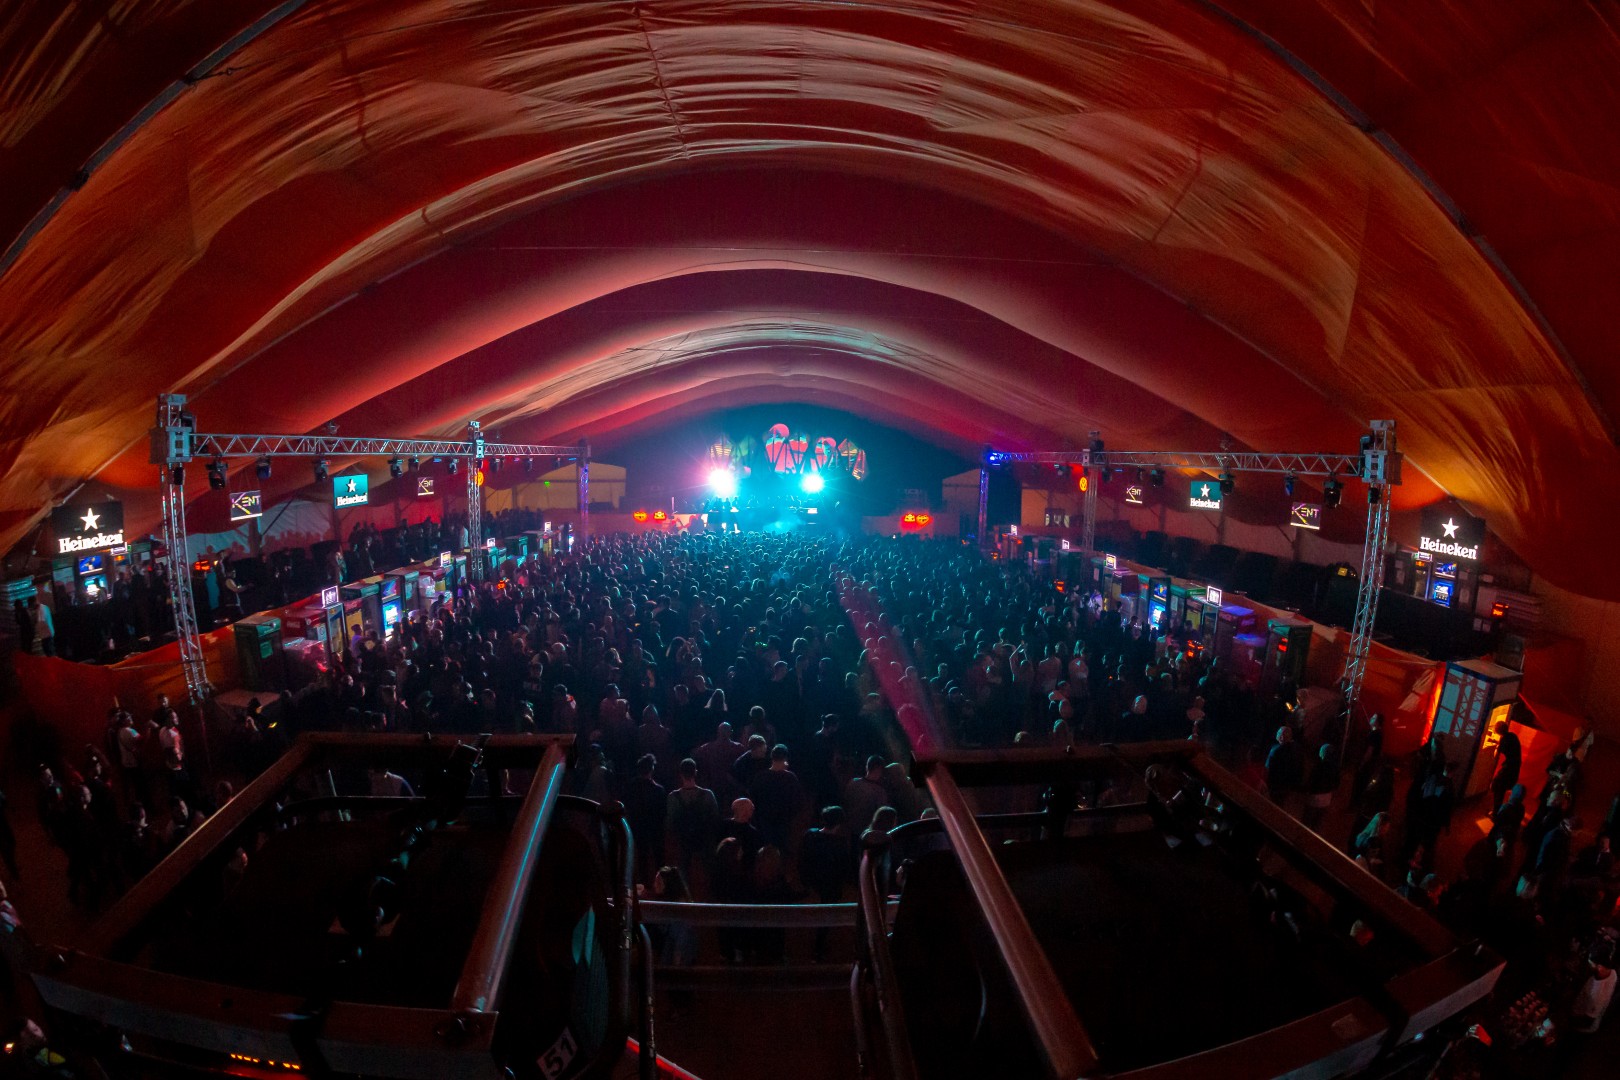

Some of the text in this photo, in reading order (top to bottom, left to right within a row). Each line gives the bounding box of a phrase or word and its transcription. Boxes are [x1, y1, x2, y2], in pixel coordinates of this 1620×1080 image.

[231, 492, 261, 515] KENT
[1291, 503, 1320, 526] KENT
[59, 530, 124, 554] Heineken
[1420, 536, 1479, 560] Heineken
[543, 1037, 573, 1076] 51
